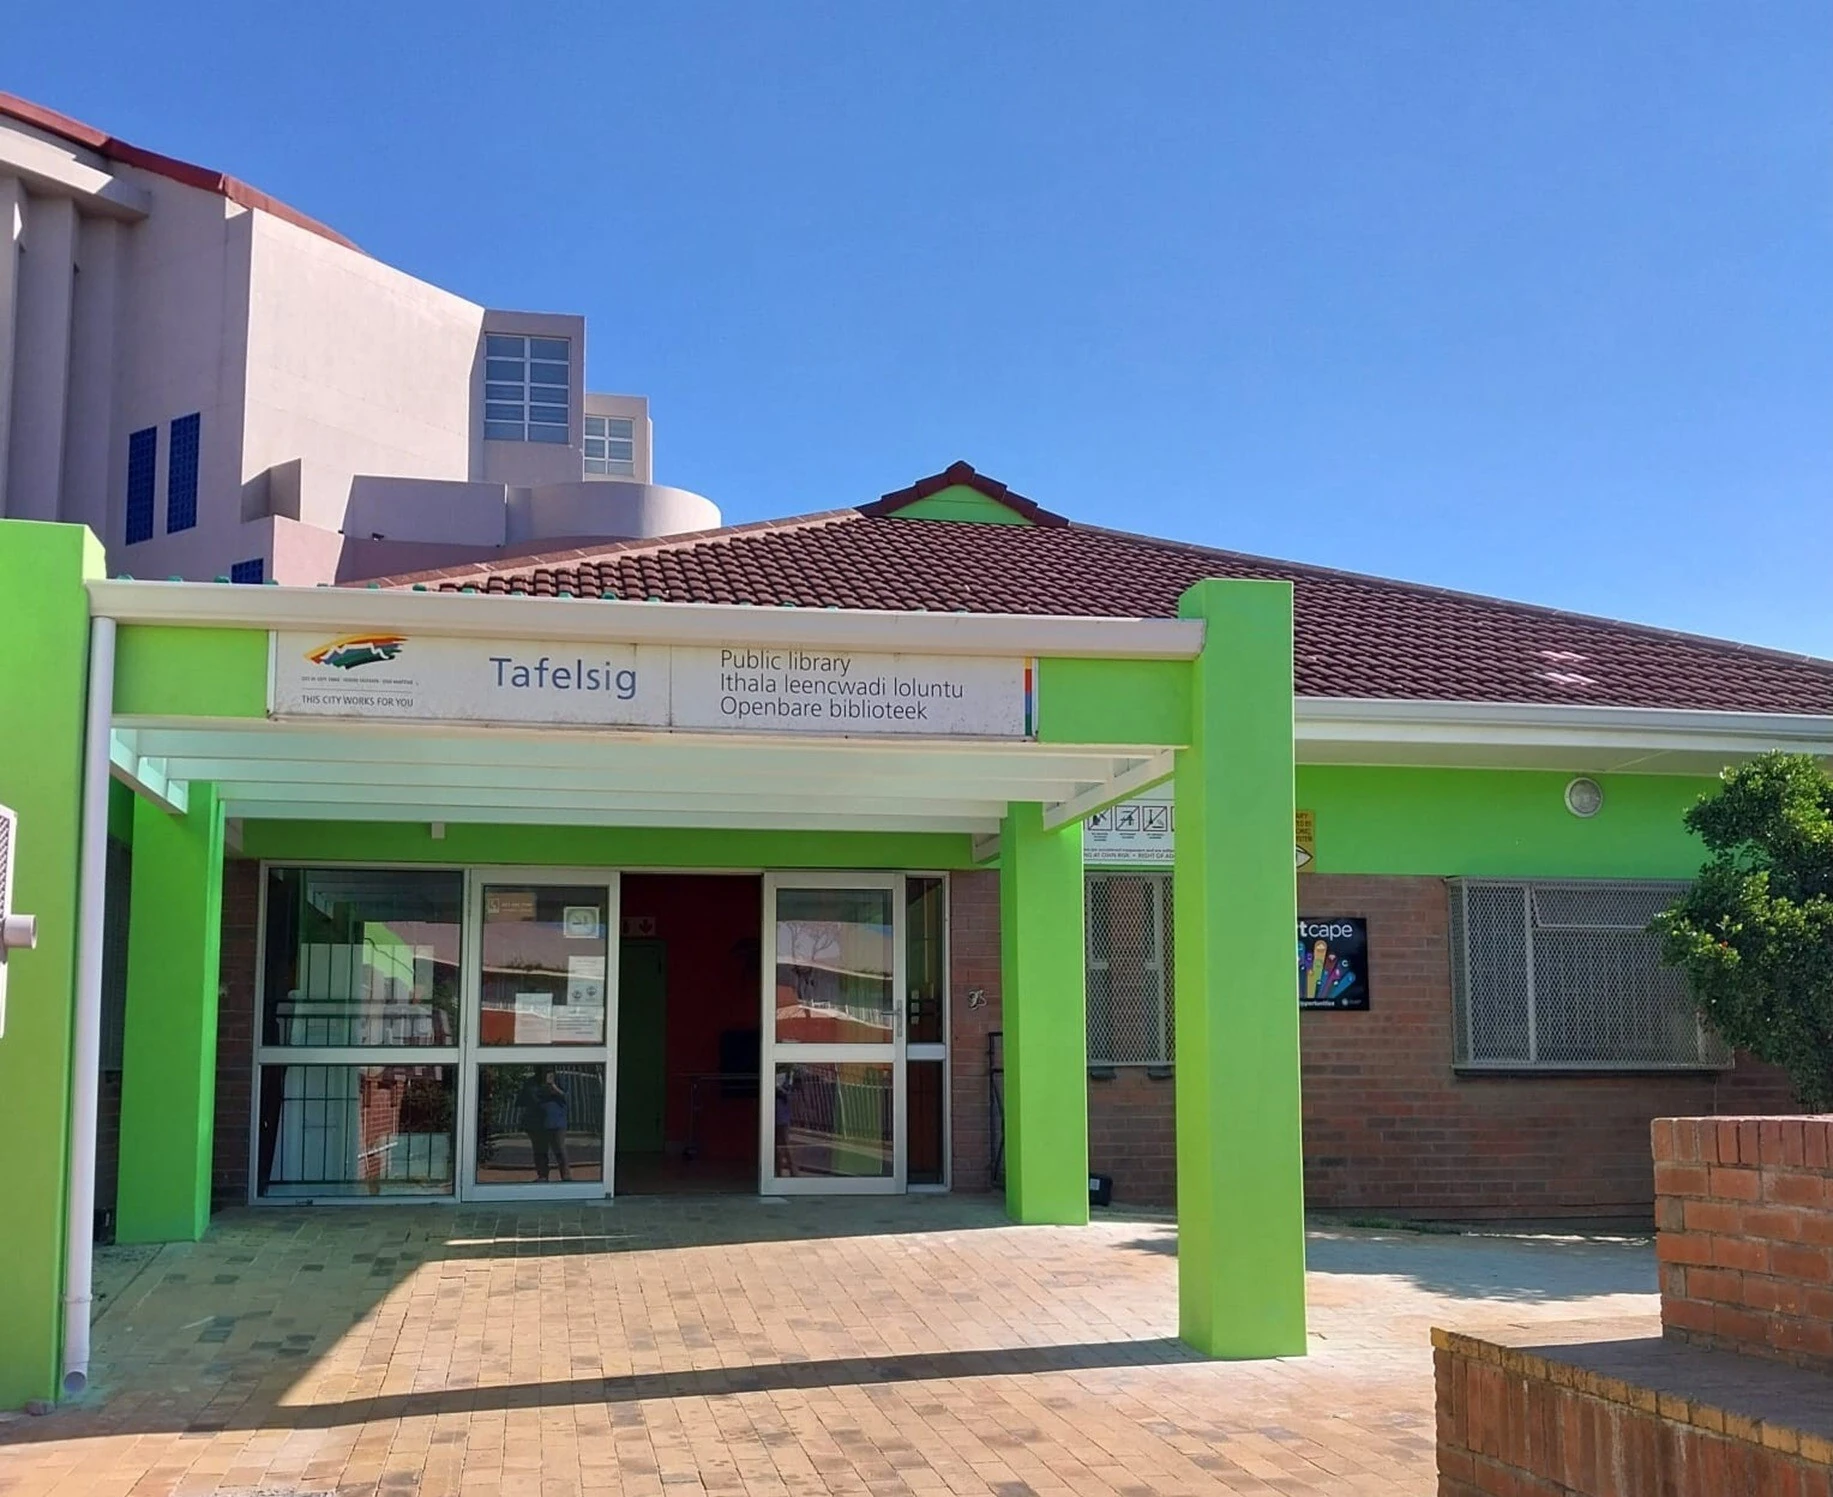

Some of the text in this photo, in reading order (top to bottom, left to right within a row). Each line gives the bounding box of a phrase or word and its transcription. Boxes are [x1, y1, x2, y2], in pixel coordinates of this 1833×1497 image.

[721, 650, 851, 677] Public library
[489, 657, 637, 700] Tafelsig
[720, 672, 964, 699] Ithala leencwadi loluntu
[302, 694, 414, 708] THIS CITY WORKS FOR YOU
[720, 696, 929, 721] Openbare biblioteek
[1298, 920, 1353, 941] tcape
